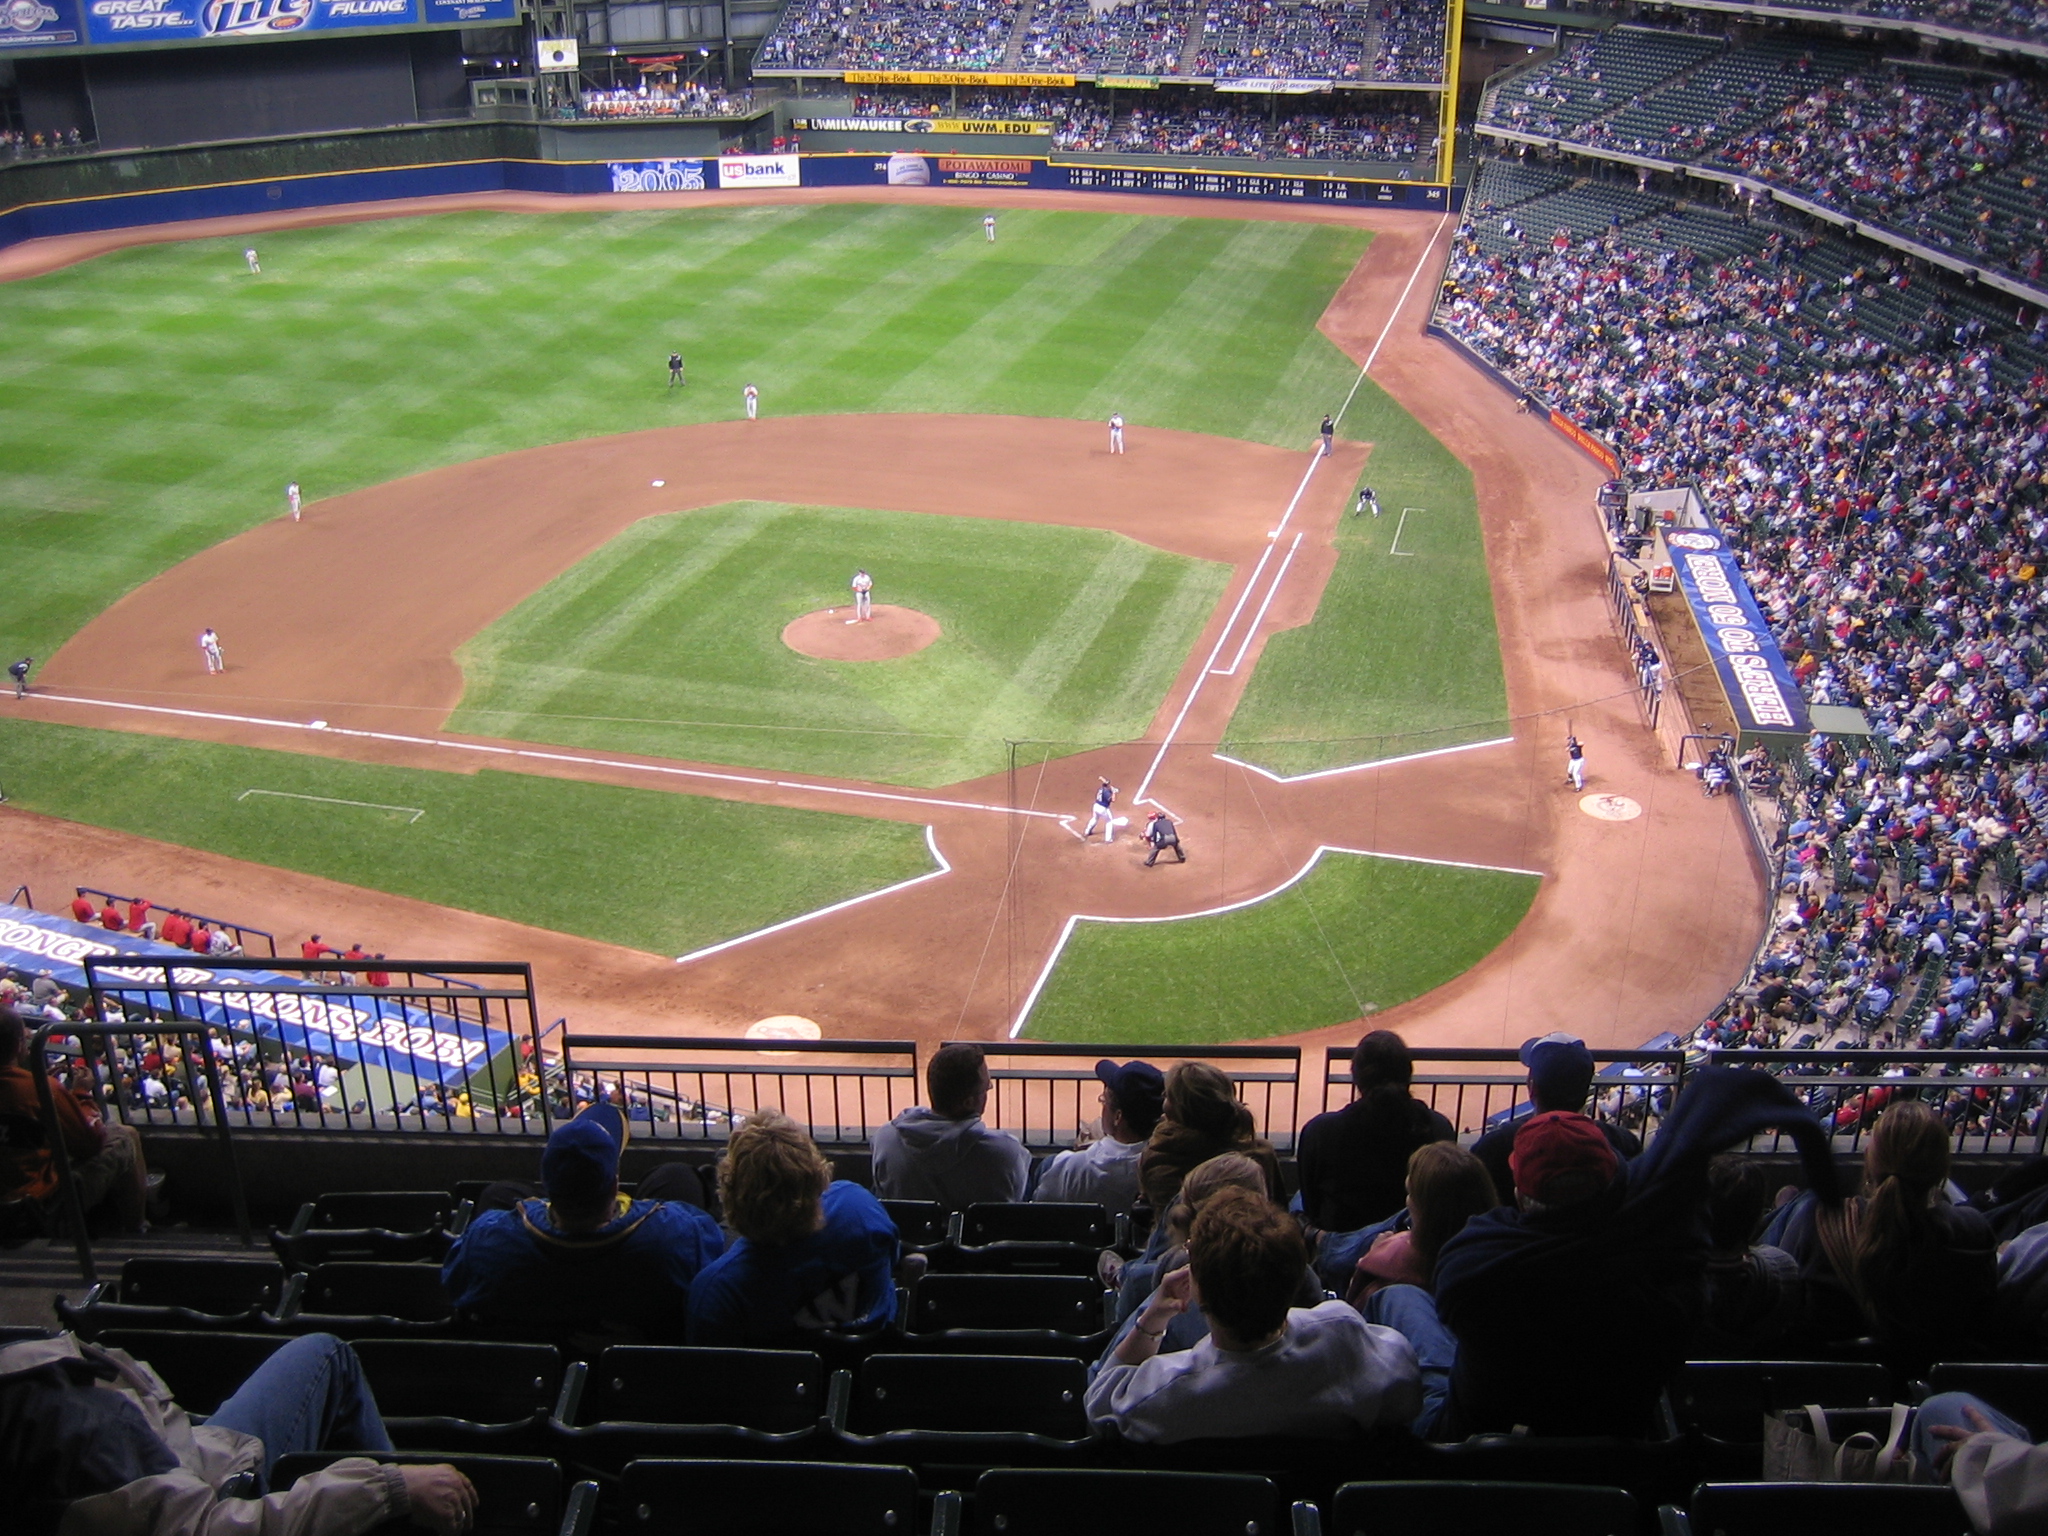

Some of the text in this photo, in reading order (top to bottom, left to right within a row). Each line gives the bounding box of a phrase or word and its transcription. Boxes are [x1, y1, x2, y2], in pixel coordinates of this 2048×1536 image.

[93, 0, 169, 15] GREAT
[111, 12, 195, 30] TASTE...
[945, 160, 1025, 171] POTAWATOMI
[619, 167, 705, 192] 2005
[1706, 603, 1748, 626] 50
[1716, 627, 1760, 653] TO
[1728, 654, 1794, 727] HERE'S
